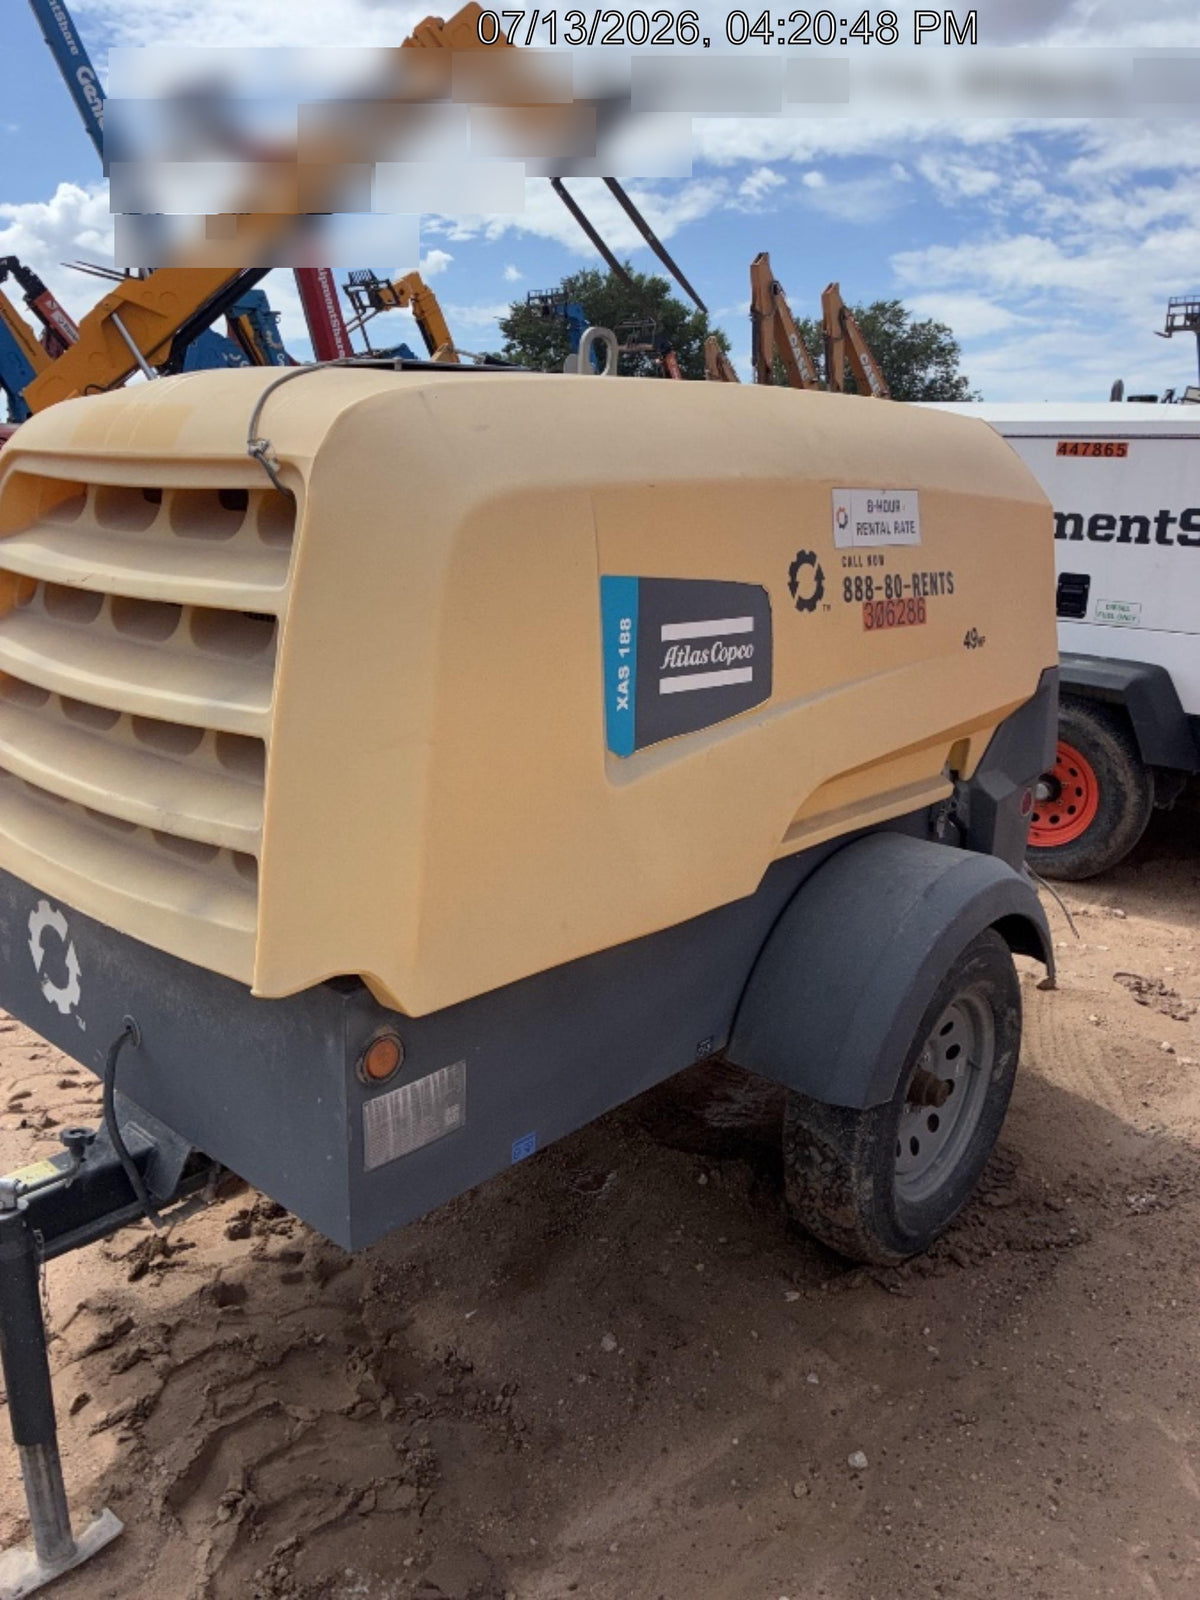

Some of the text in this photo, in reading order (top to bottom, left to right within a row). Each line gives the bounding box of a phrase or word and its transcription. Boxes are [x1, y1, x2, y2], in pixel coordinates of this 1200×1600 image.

[1057, 442, 1128, 458] 447865
[866, 498, 901, 514] 8-HOUR
[855, 519, 917, 537] RENTAL RATE
[842, 554, 885, 568] CALL NOW
[843, 571, 954, 603] 888-80-RENTS
[864, 597, 927, 629] 306286
[616, 616, 633, 713] XAS 188
[659, 640, 755, 670] Atlas Copco
